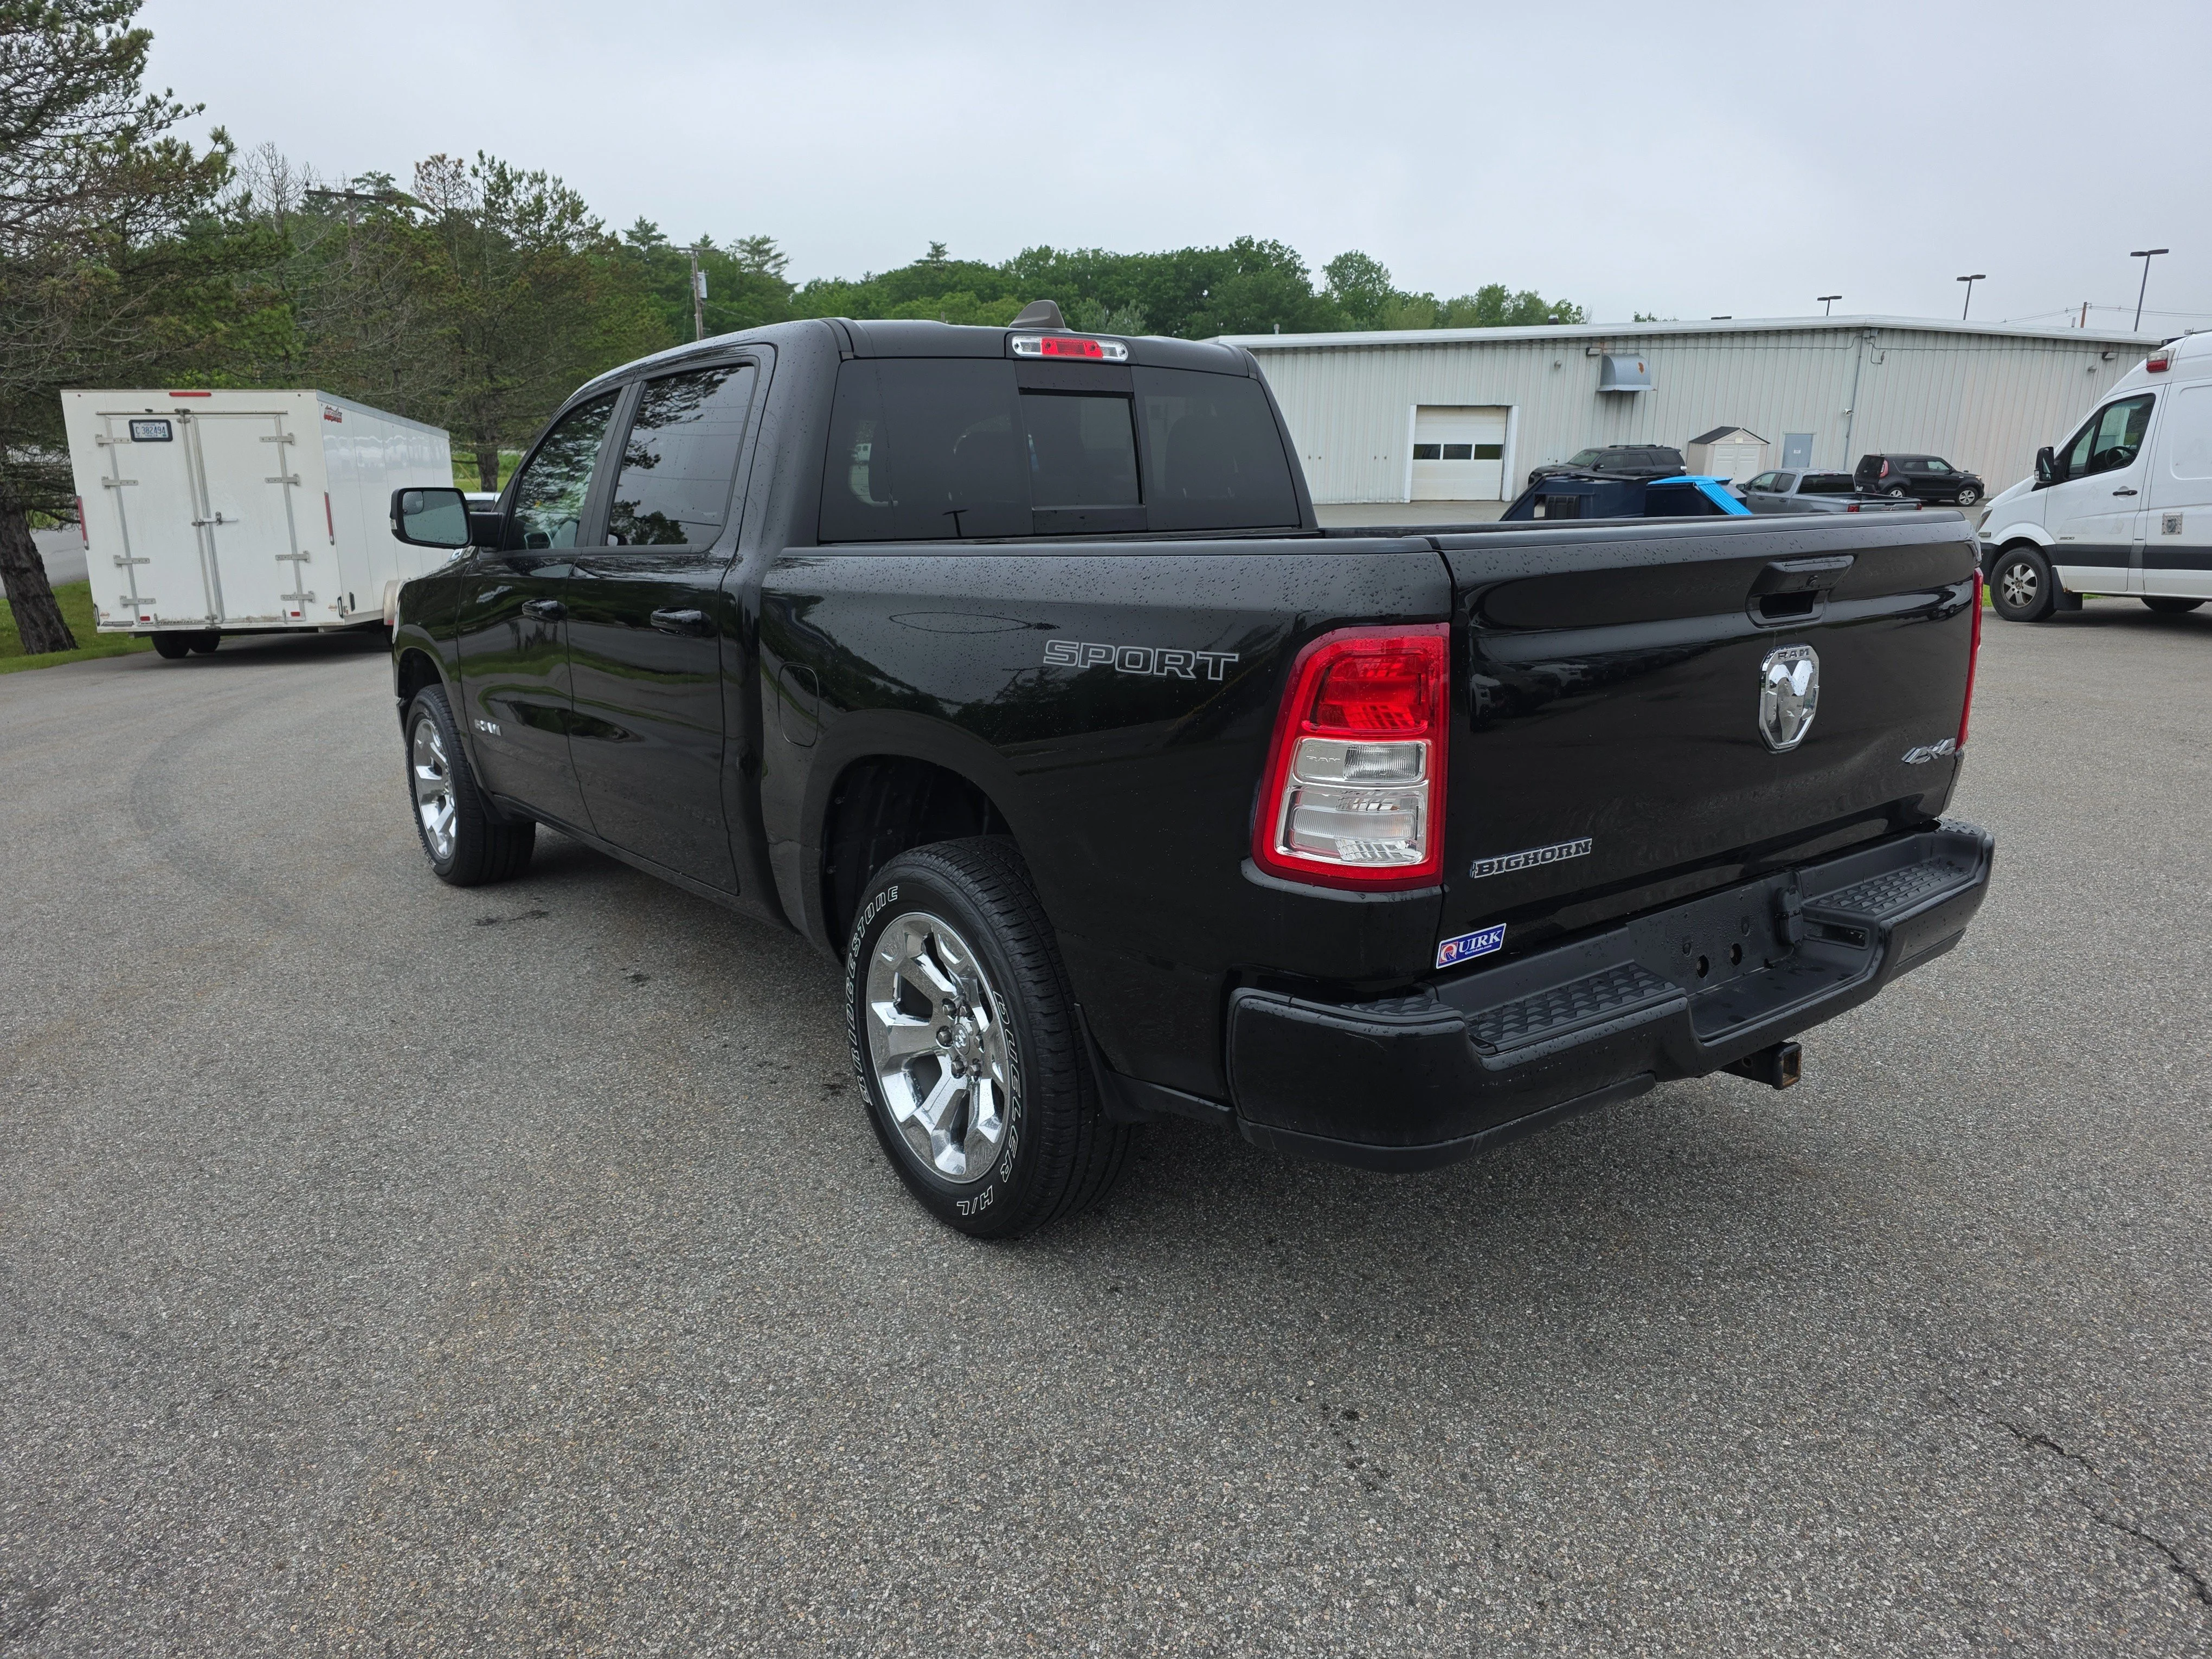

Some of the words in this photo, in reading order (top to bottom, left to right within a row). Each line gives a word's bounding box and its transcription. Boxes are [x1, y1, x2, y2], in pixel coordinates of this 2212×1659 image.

[1043, 639, 1239, 681] SPORT
[1778, 648, 1809, 659] RAM
[474, 719, 501, 736] RAM
[1306, 755, 1341, 763] RAM
[1471, 837, 1593, 879] BIGHORN
[1440, 930, 1502, 962] QUIRK
[845, 885, 899, 1107] BRIDGESTONE
[993, 991, 1021, 1183] DUELER
[956, 1185, 994, 1216] H/L
